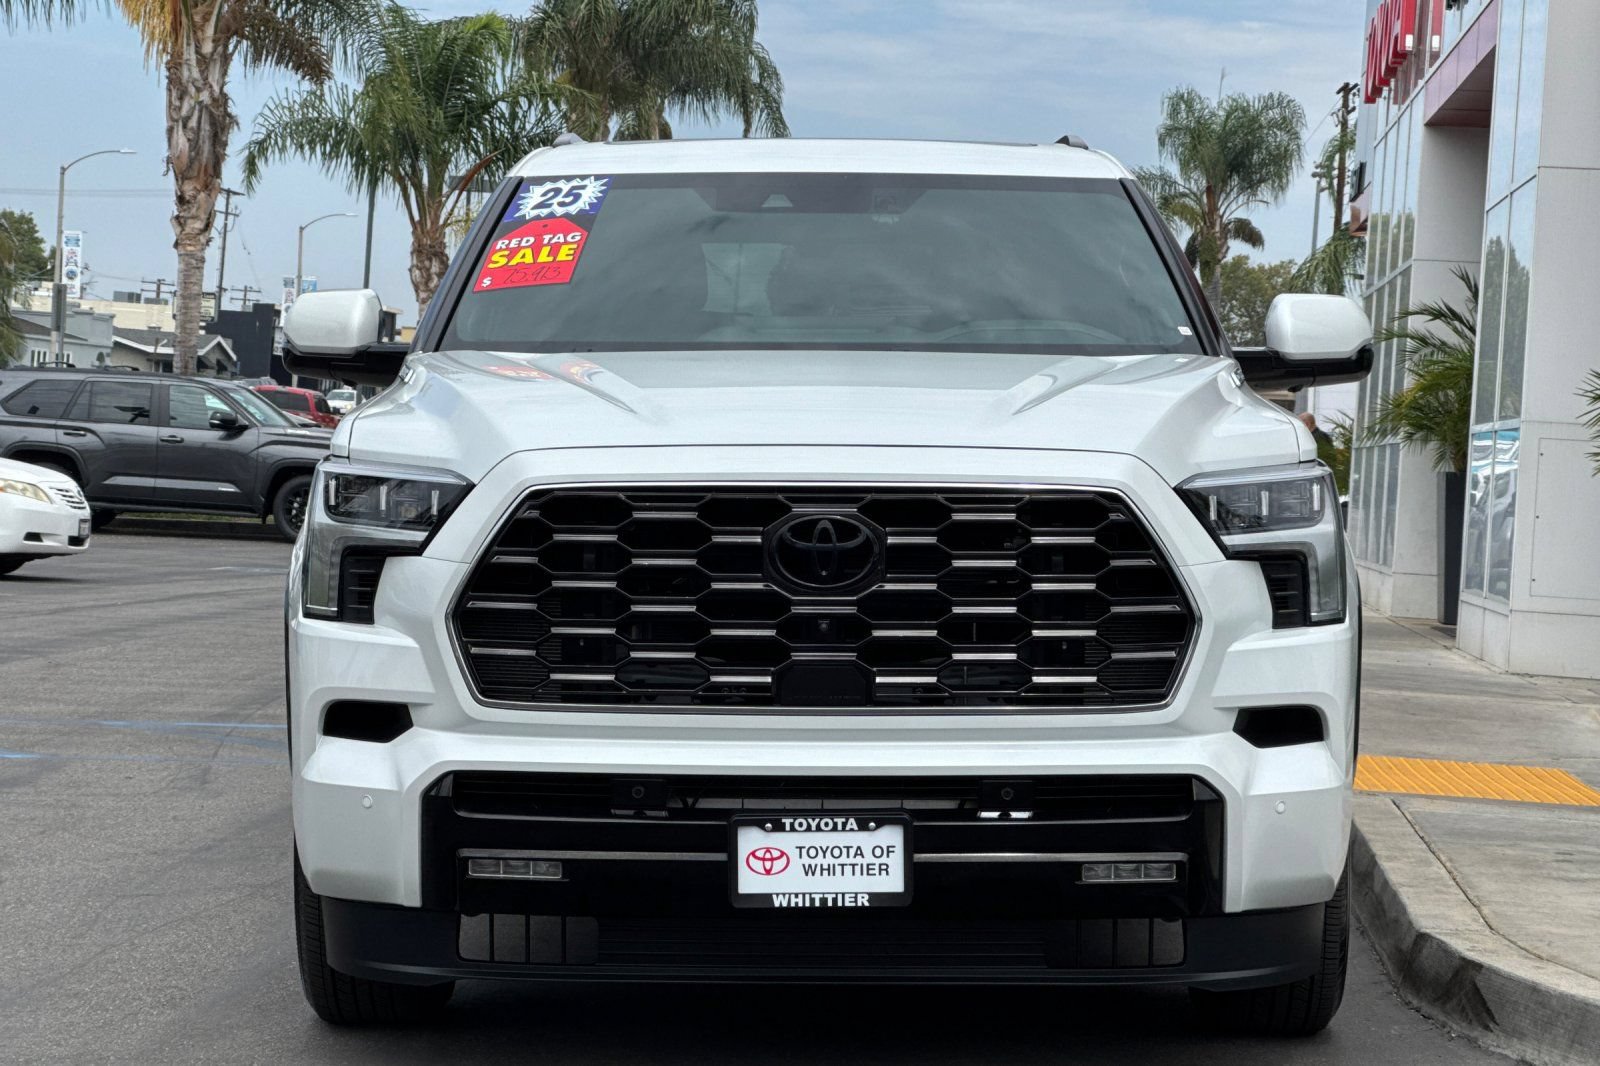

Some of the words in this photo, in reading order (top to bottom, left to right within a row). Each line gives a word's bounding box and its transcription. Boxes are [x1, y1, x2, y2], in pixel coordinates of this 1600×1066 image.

[531, 184, 588, 210] 25
[496, 236, 535, 250] RED
[543, 232, 582, 244] TAG
[487, 243, 578, 269] SALE
[481, 277, 492, 287] $
[782, 818, 858, 831] TOYOTA
[795, 846, 865, 859] TOYOTA
[872, 845, 896, 859] OF
[802, 863, 890, 877] WHITTIER
[772, 894, 870, 907] WHITTIER
